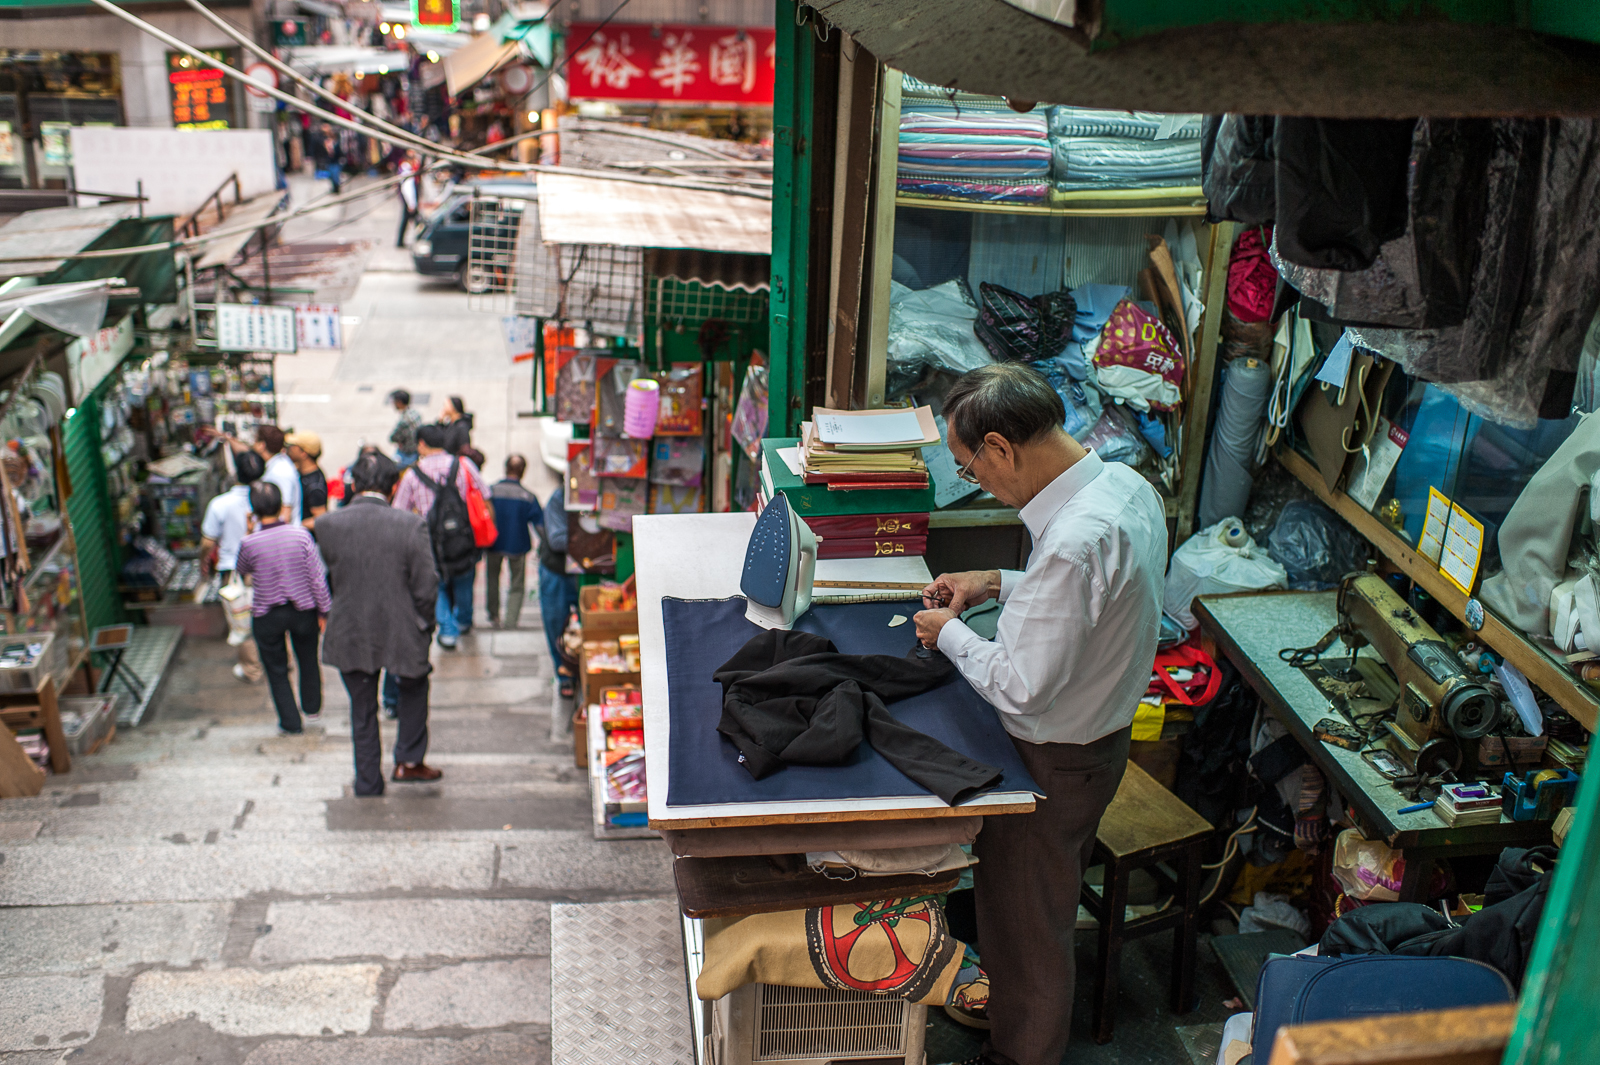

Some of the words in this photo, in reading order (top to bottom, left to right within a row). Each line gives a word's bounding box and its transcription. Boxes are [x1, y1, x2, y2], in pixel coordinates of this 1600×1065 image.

[575, 31, 775, 96] 裕華國
[895, 543, 905, 553] B
